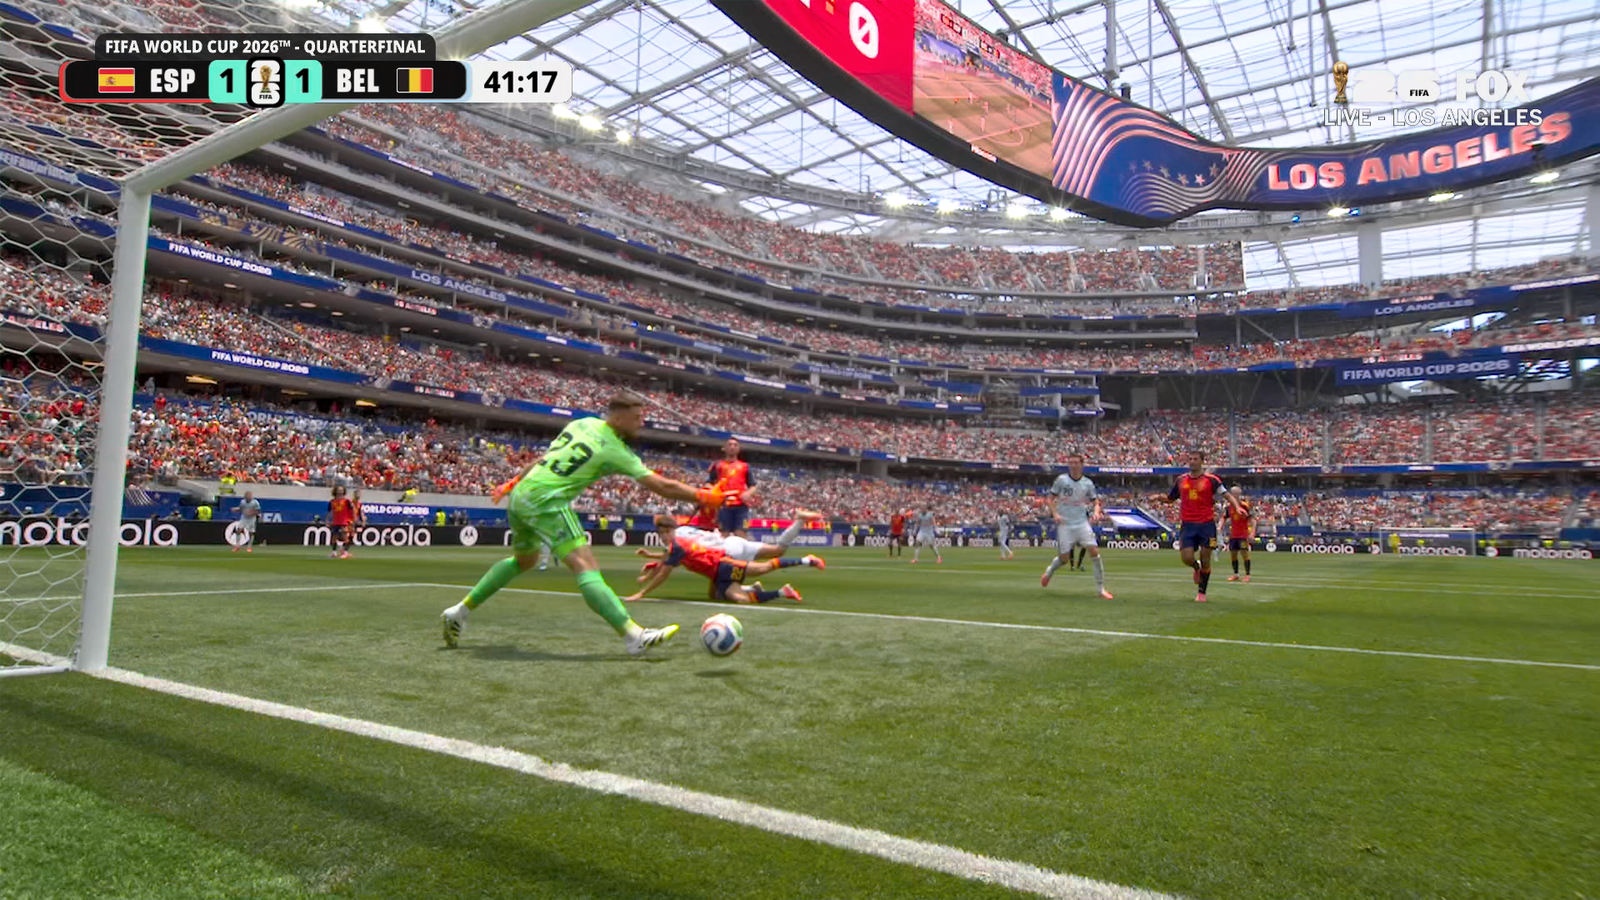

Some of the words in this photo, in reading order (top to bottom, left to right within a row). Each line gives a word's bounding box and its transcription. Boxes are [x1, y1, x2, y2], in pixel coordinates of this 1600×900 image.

[1268, 161, 1347, 191] LOS
[1356, 111, 1573, 186] ANGELES
[168, 242, 190, 255] FIFA
[190, 247, 224, 263] WORLD
[224, 257, 242, 268] CUP
[411, 270, 442, 285] LOS
[443, 279, 507, 302] ANGELES
[1374, 306, 1403, 315] LOS
[211, 351, 231, 362] FIFA
[232, 354, 263, 367] WORLD
[263, 359, 280, 369] CUP
[1343, 368, 1372, 380] FIFA
[1373, 366, 1424, 379] WORLD
[1425, 364, 1455, 375] CUP
[1456, 359, 1510, 374] 2026
[540, 431, 593, 476] 23
[386, 505, 402, 515] CUP
[0, 517, 179, 546] otoola
[303, 524, 431, 547] mtorola
[1107, 540, 1160, 550] motorola
[1291, 543, 1355, 554] motorola
[1397, 545, 1467, 557] motorola
[1512, 547, 1594, 560] motorola
